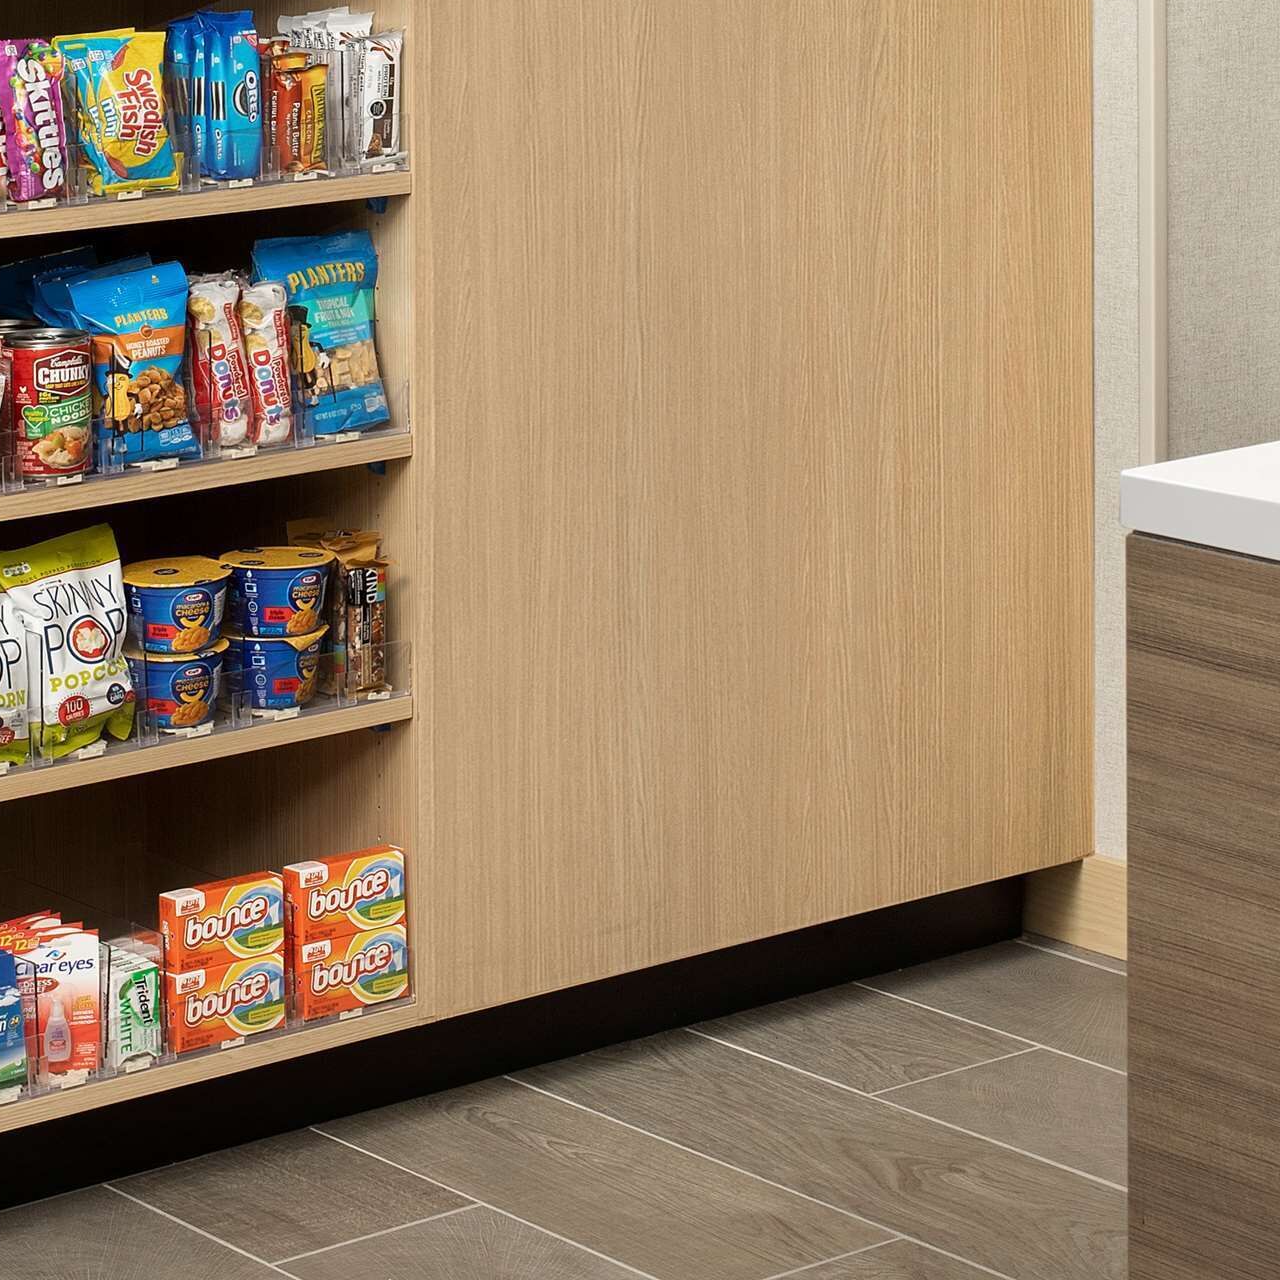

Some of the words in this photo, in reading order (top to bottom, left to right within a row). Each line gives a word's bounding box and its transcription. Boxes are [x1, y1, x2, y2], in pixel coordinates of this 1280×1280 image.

[116, 90, 142, 139] Fish
[124, 68, 163, 157] Swedish
[244, 69, 259, 123] OREO
[292, 102, 301, 130] Peanut
[16, 58, 64, 190] Skittles
[291, 131, 301, 158] Butter
[287, 261, 366, 294] PLANTERS
[114, 308, 169, 328] PLANTERS
[37, 364, 90, 385] CHUNKY
[132, 345, 167, 360] PEANUTS
[228, 352, 246, 396] Powdered
[273, 359, 290, 407] Powdered
[49, 400, 90, 418] CHICKE
[51, 409, 90, 425] NOODL
[33, 574, 118, 621] SKINNY
[64, 697, 84, 713] 100
[309, 869, 390, 919] bounce
[186, 898, 268, 948] bounce
[58, 958, 94, 976] eyes
[312, 943, 392, 994] bounce
[134, 975, 154, 1025] Trident
[186, 973, 268, 1025] bounce
[119, 998, 133, 1054] WHITE
